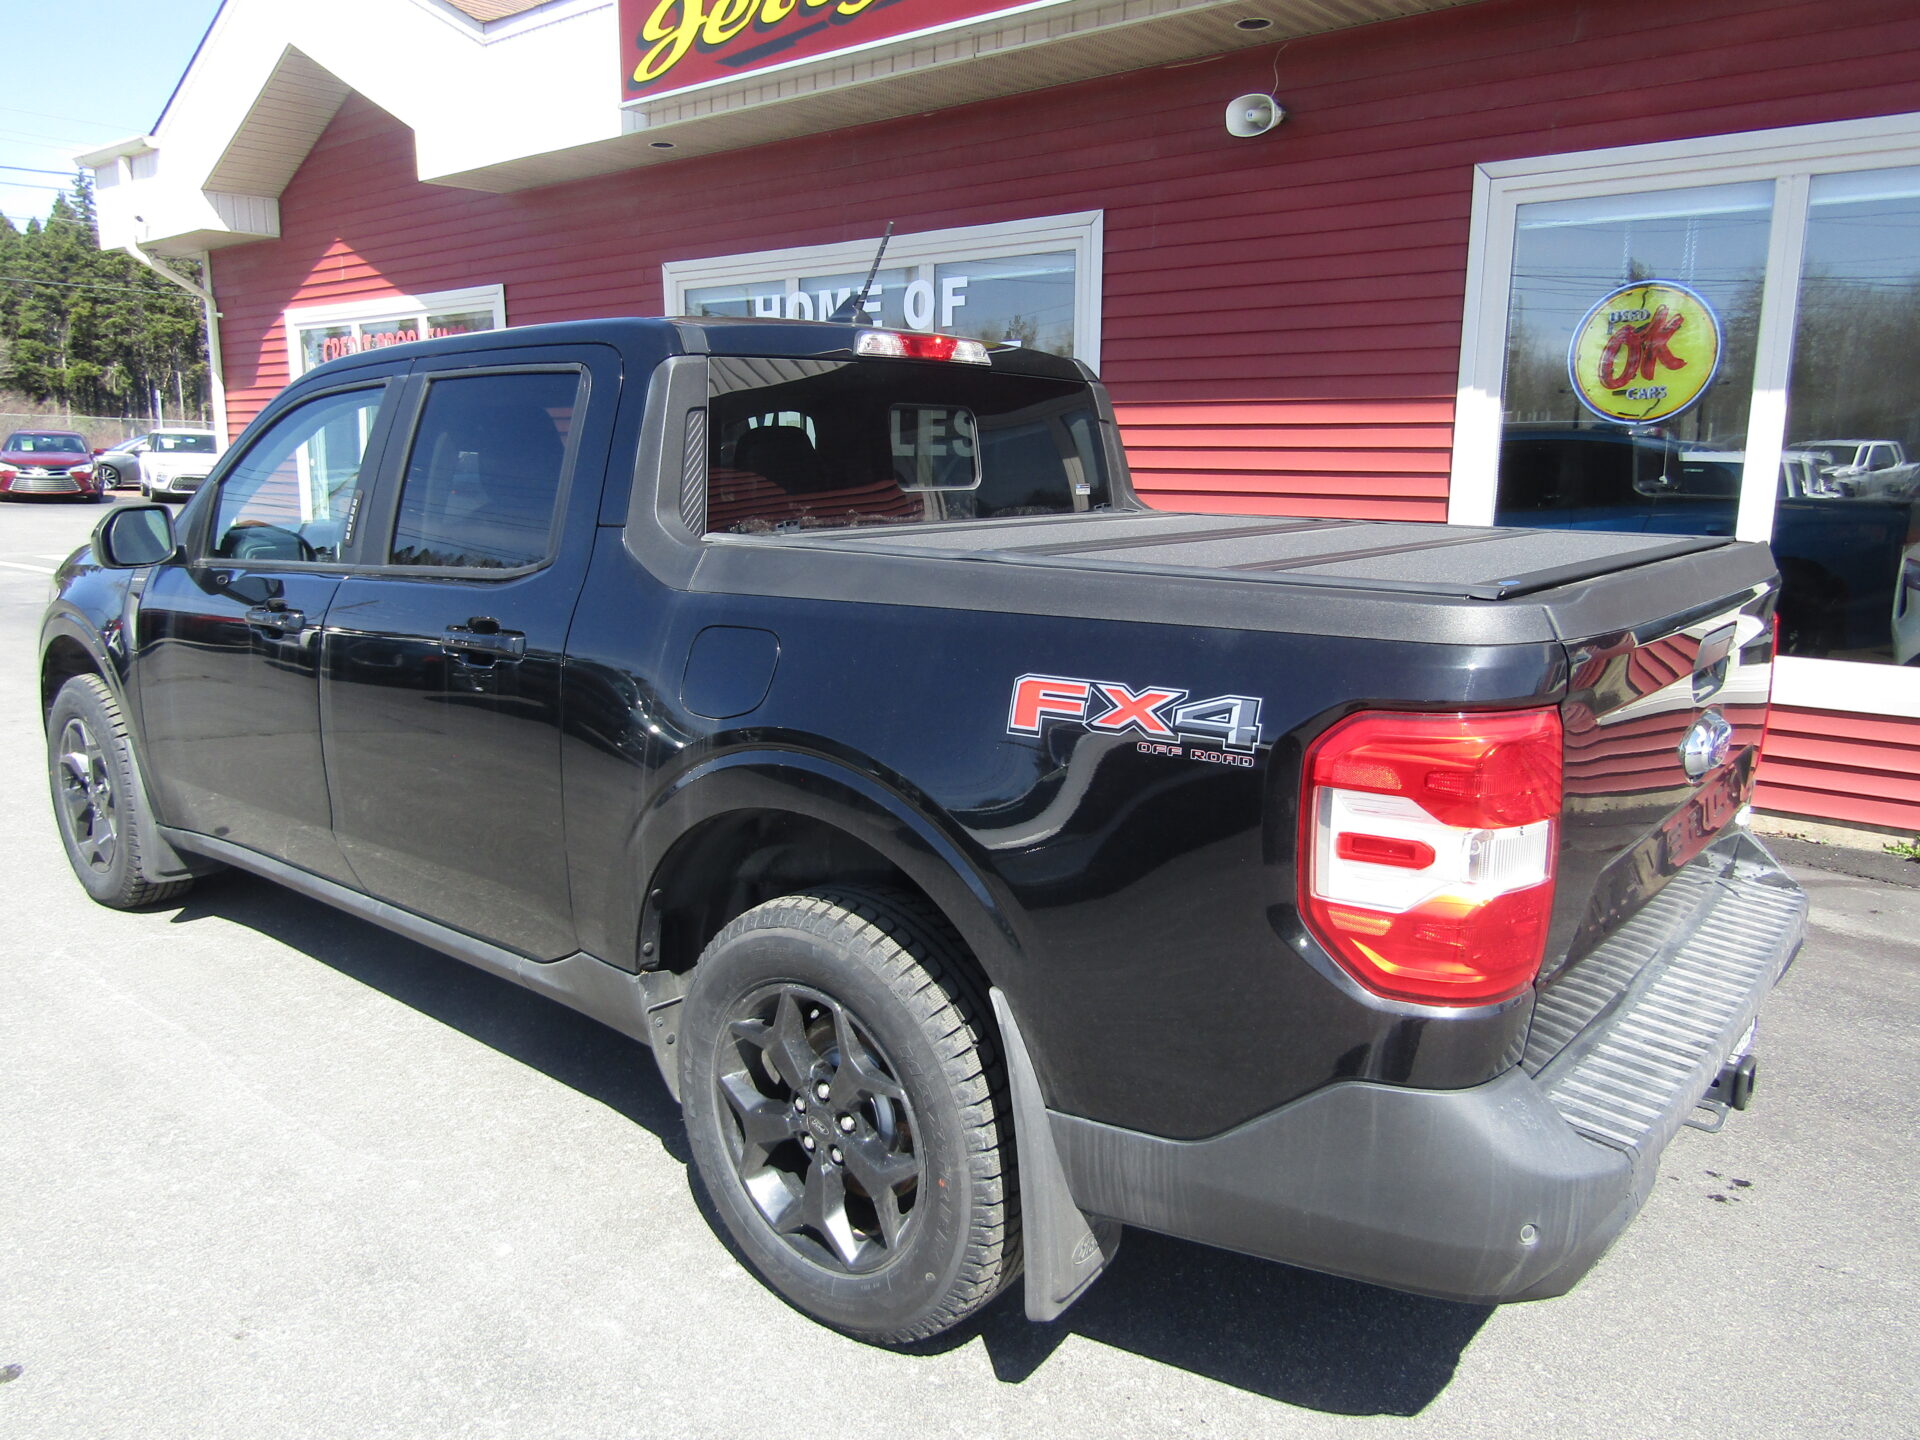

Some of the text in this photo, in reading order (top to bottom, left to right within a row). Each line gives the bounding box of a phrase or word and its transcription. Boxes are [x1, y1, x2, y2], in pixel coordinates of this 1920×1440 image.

[903, 276, 968, 330] OF
[1598, 304, 1688, 390] OK
[1006, 673, 1262, 754] FX4
[1136, 741, 1256, 768] OFF ROAD
